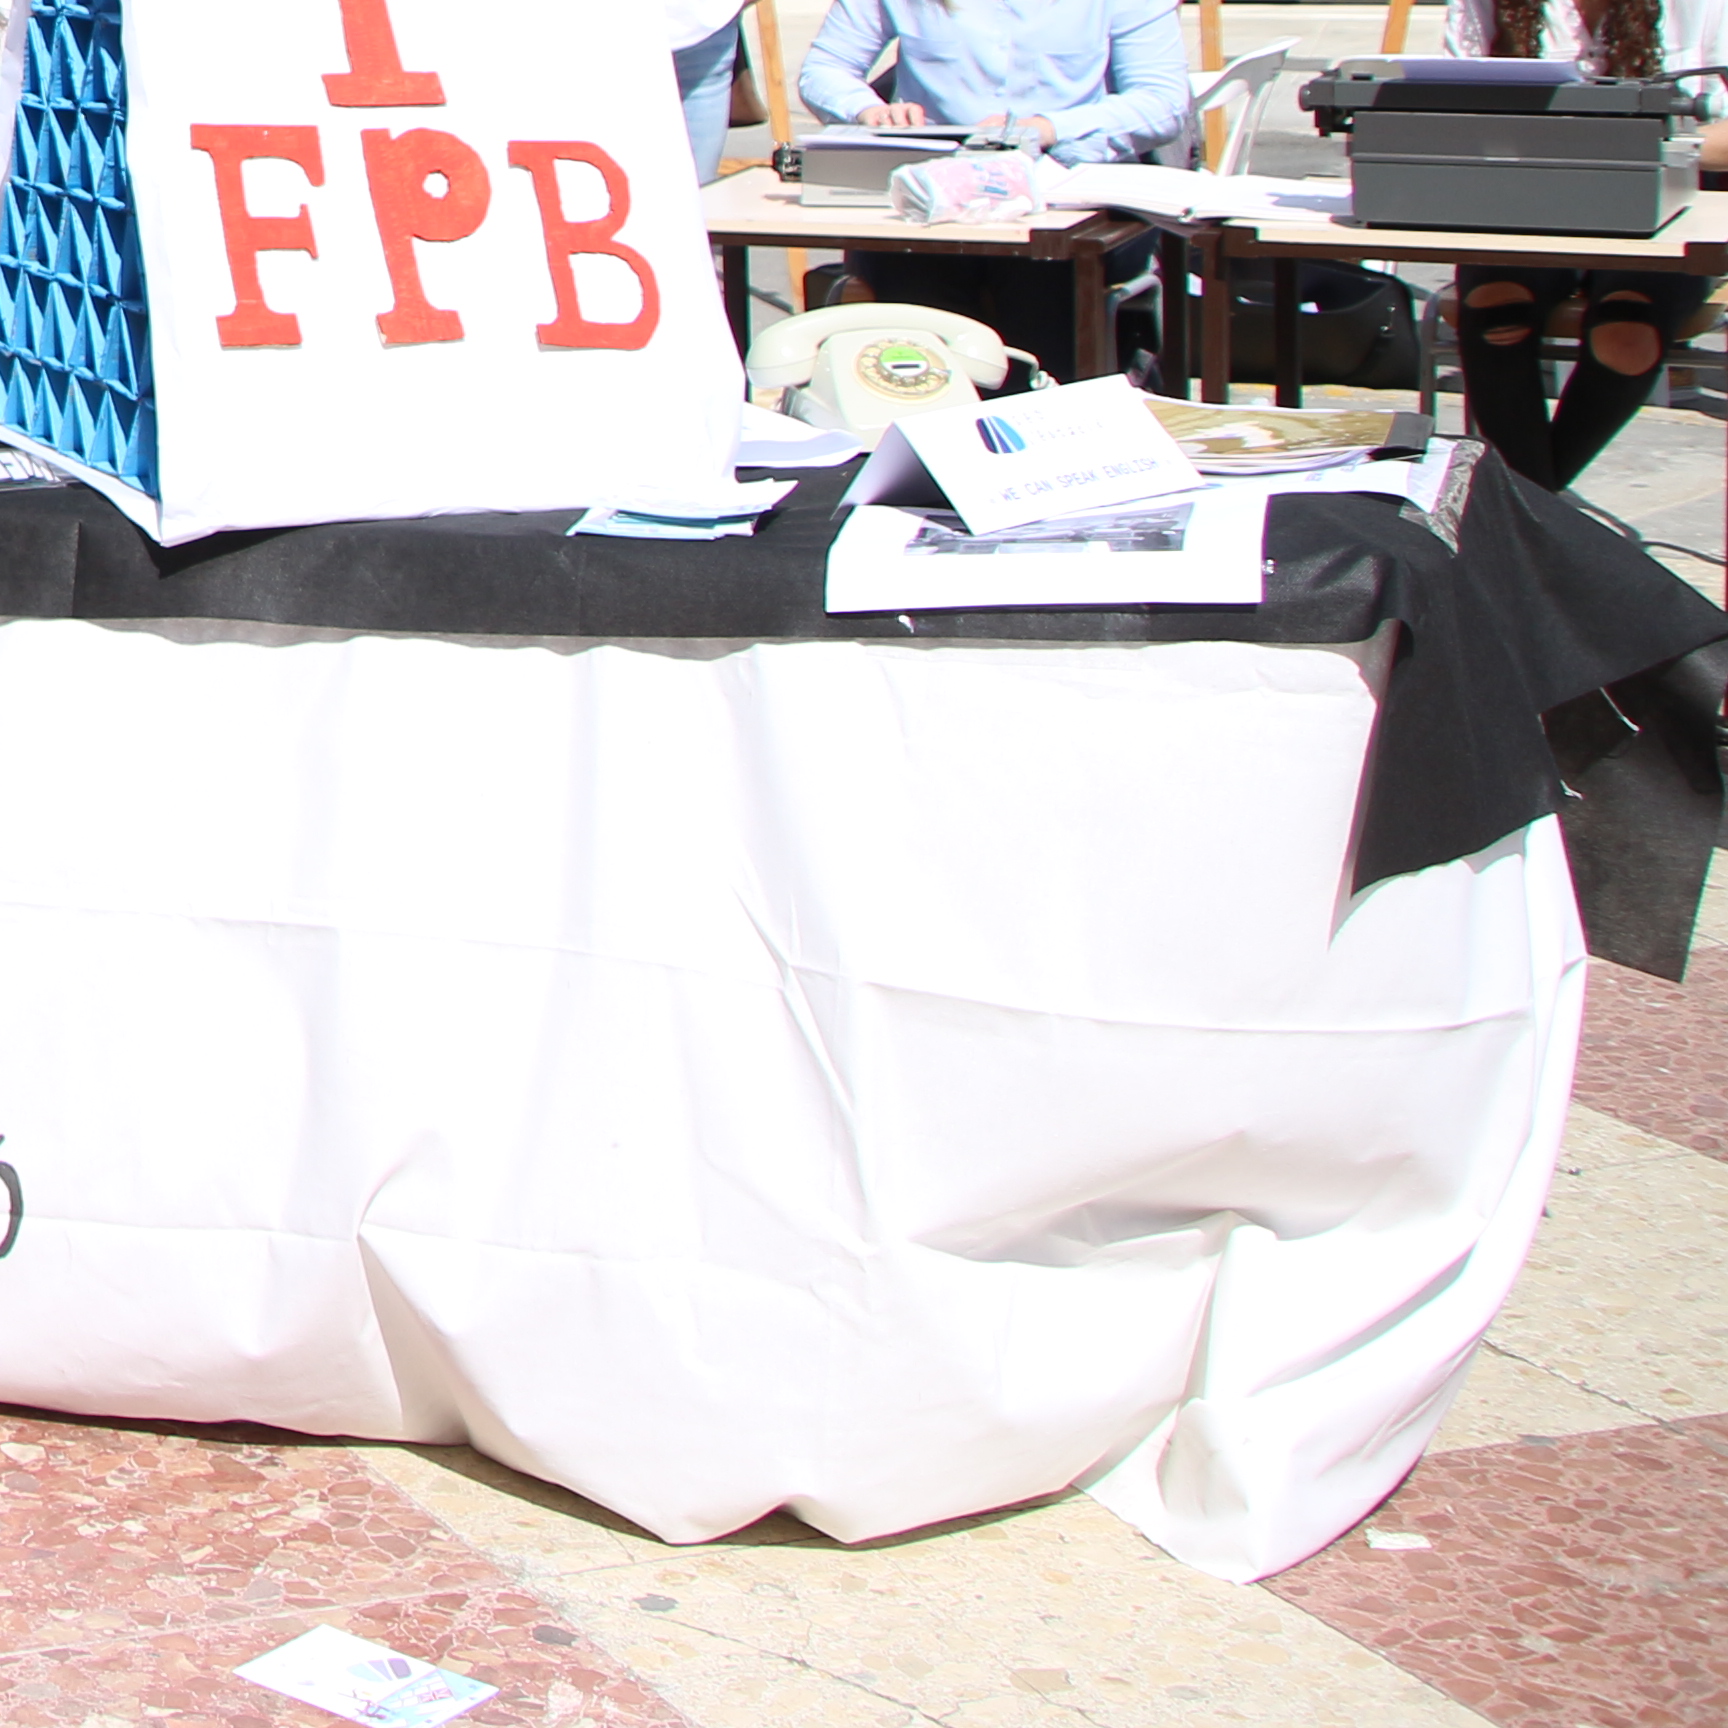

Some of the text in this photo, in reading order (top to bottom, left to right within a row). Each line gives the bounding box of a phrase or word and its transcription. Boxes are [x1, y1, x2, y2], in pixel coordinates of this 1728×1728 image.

[190, 124, 661, 353] FPB
[999, 457, 1161, 502] WE CAN SPEAK ENGLISH
